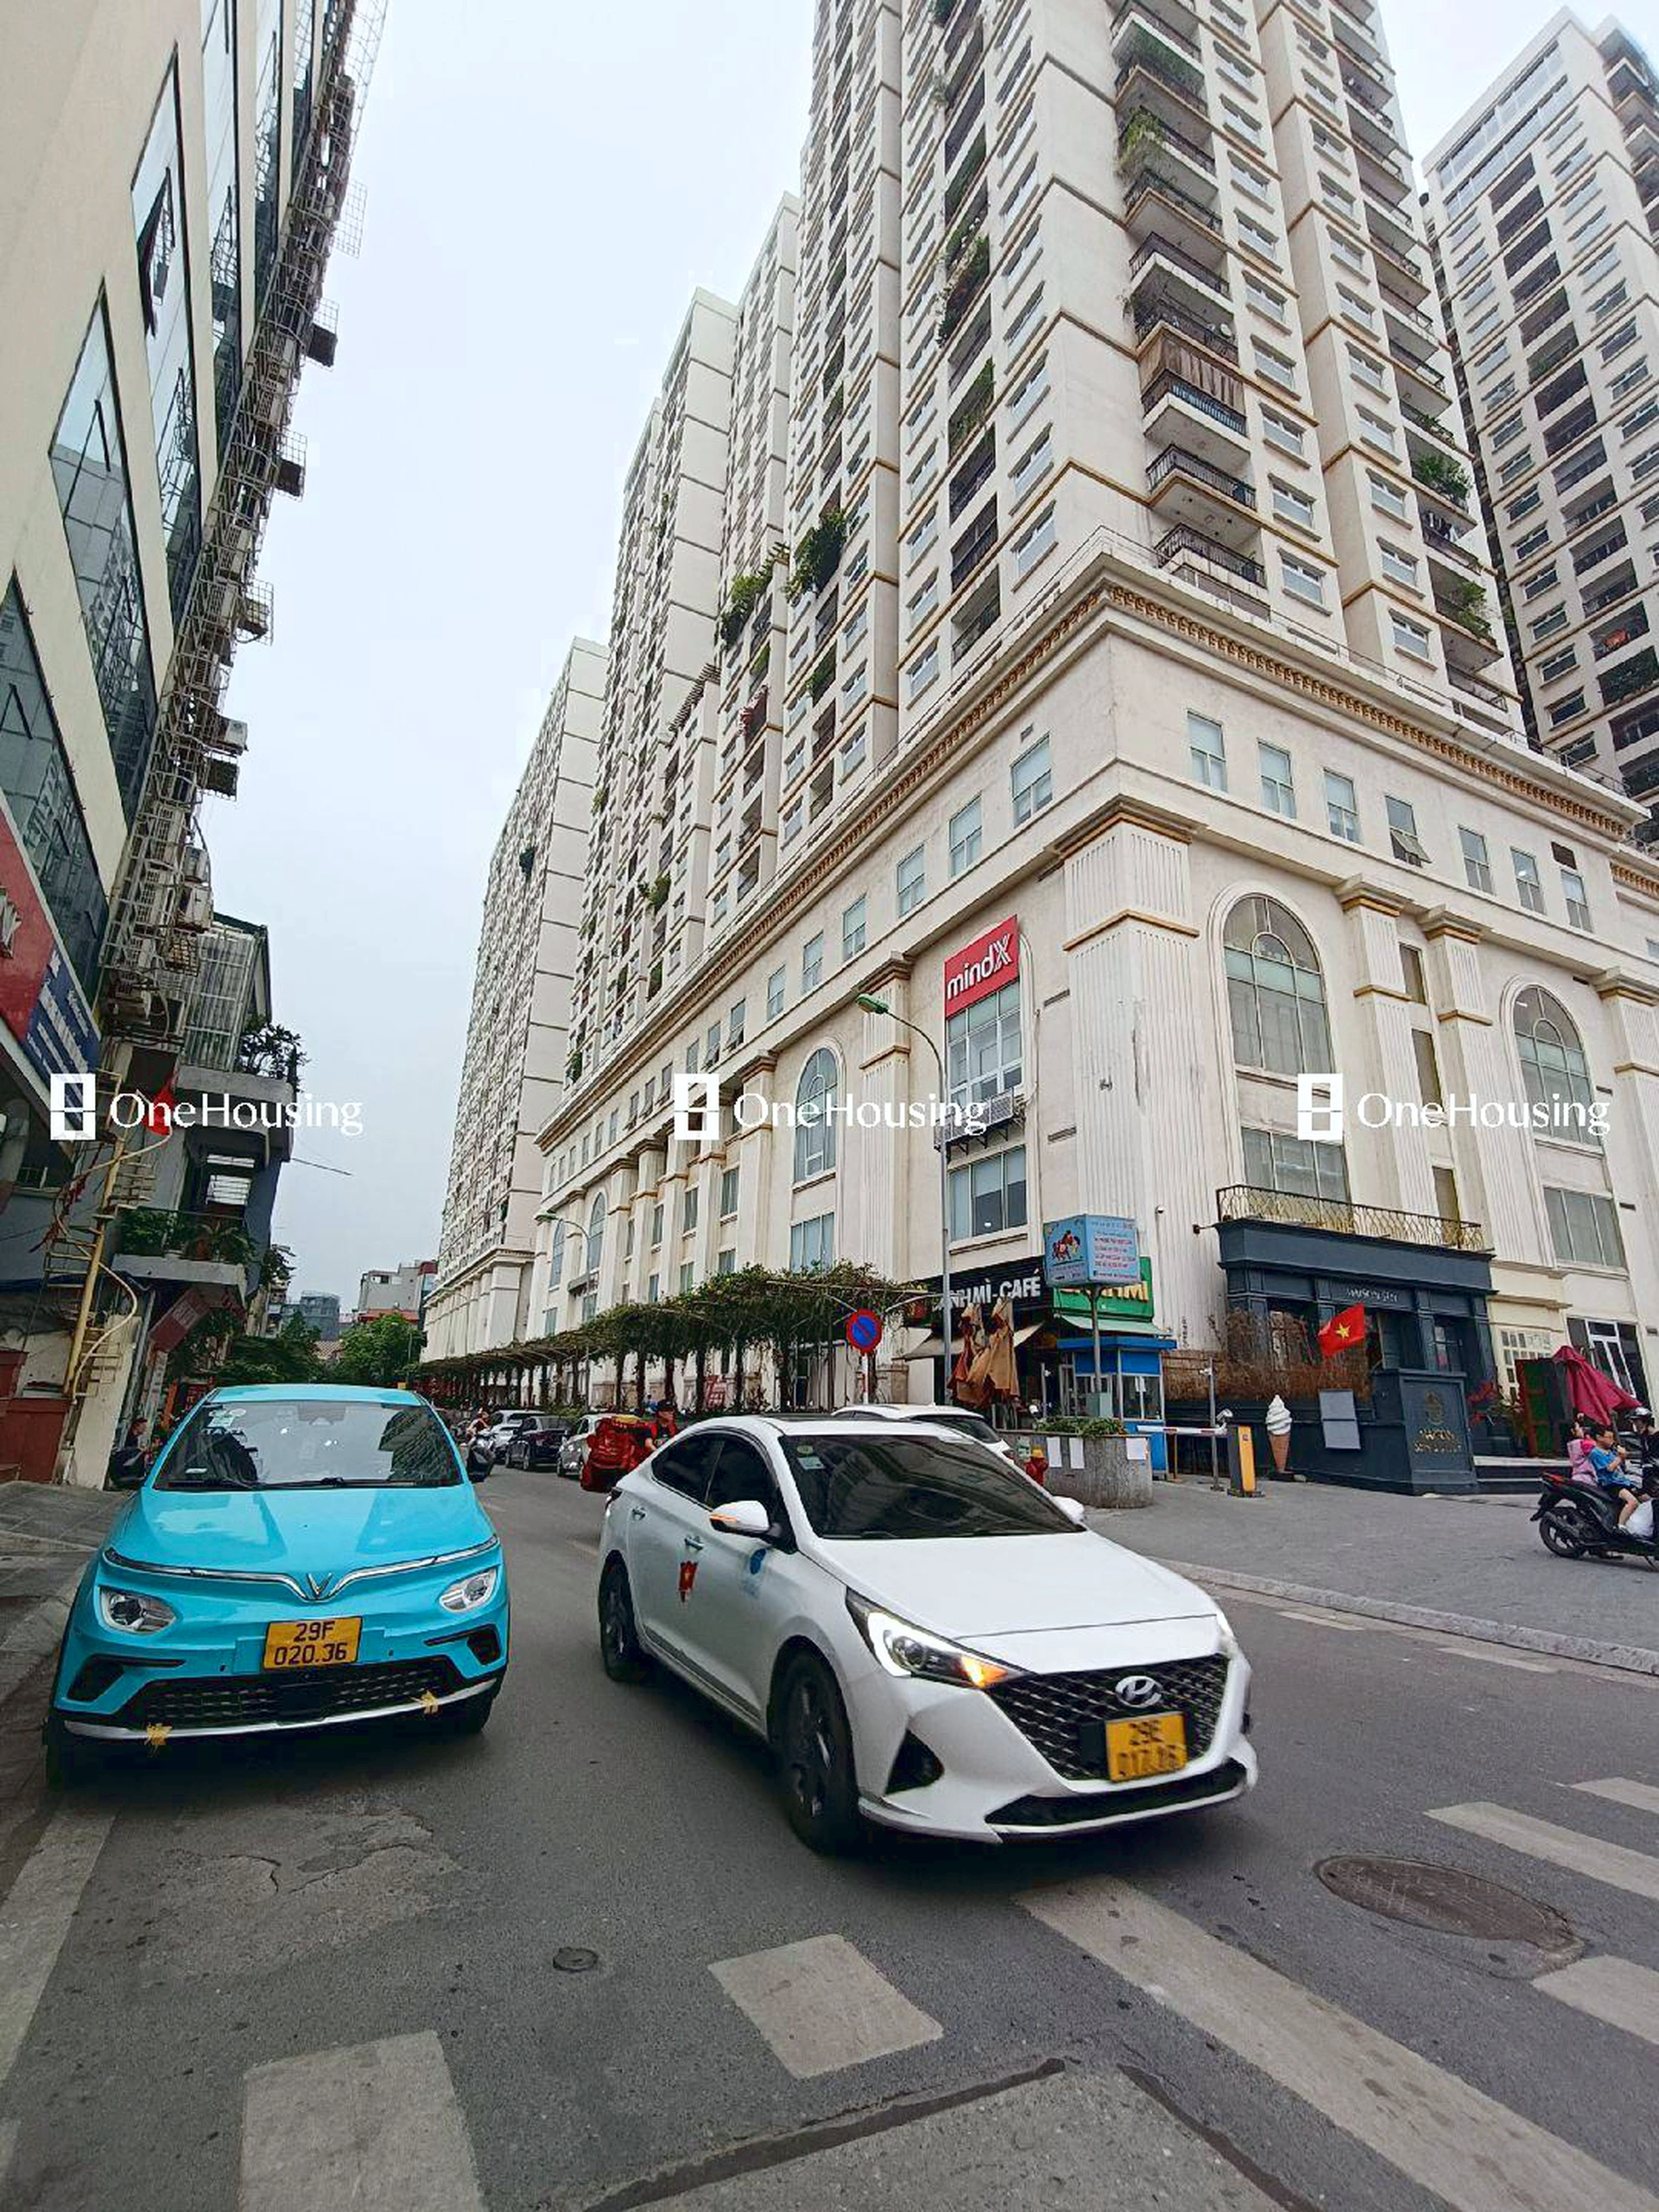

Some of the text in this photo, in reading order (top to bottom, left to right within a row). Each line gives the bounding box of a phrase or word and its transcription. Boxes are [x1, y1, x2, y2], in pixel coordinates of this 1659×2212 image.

[947, 935, 1013, 1000] mindX
[294, 1619, 335, 1643] 29F
[274, 1642, 348, 1666] 020.36
